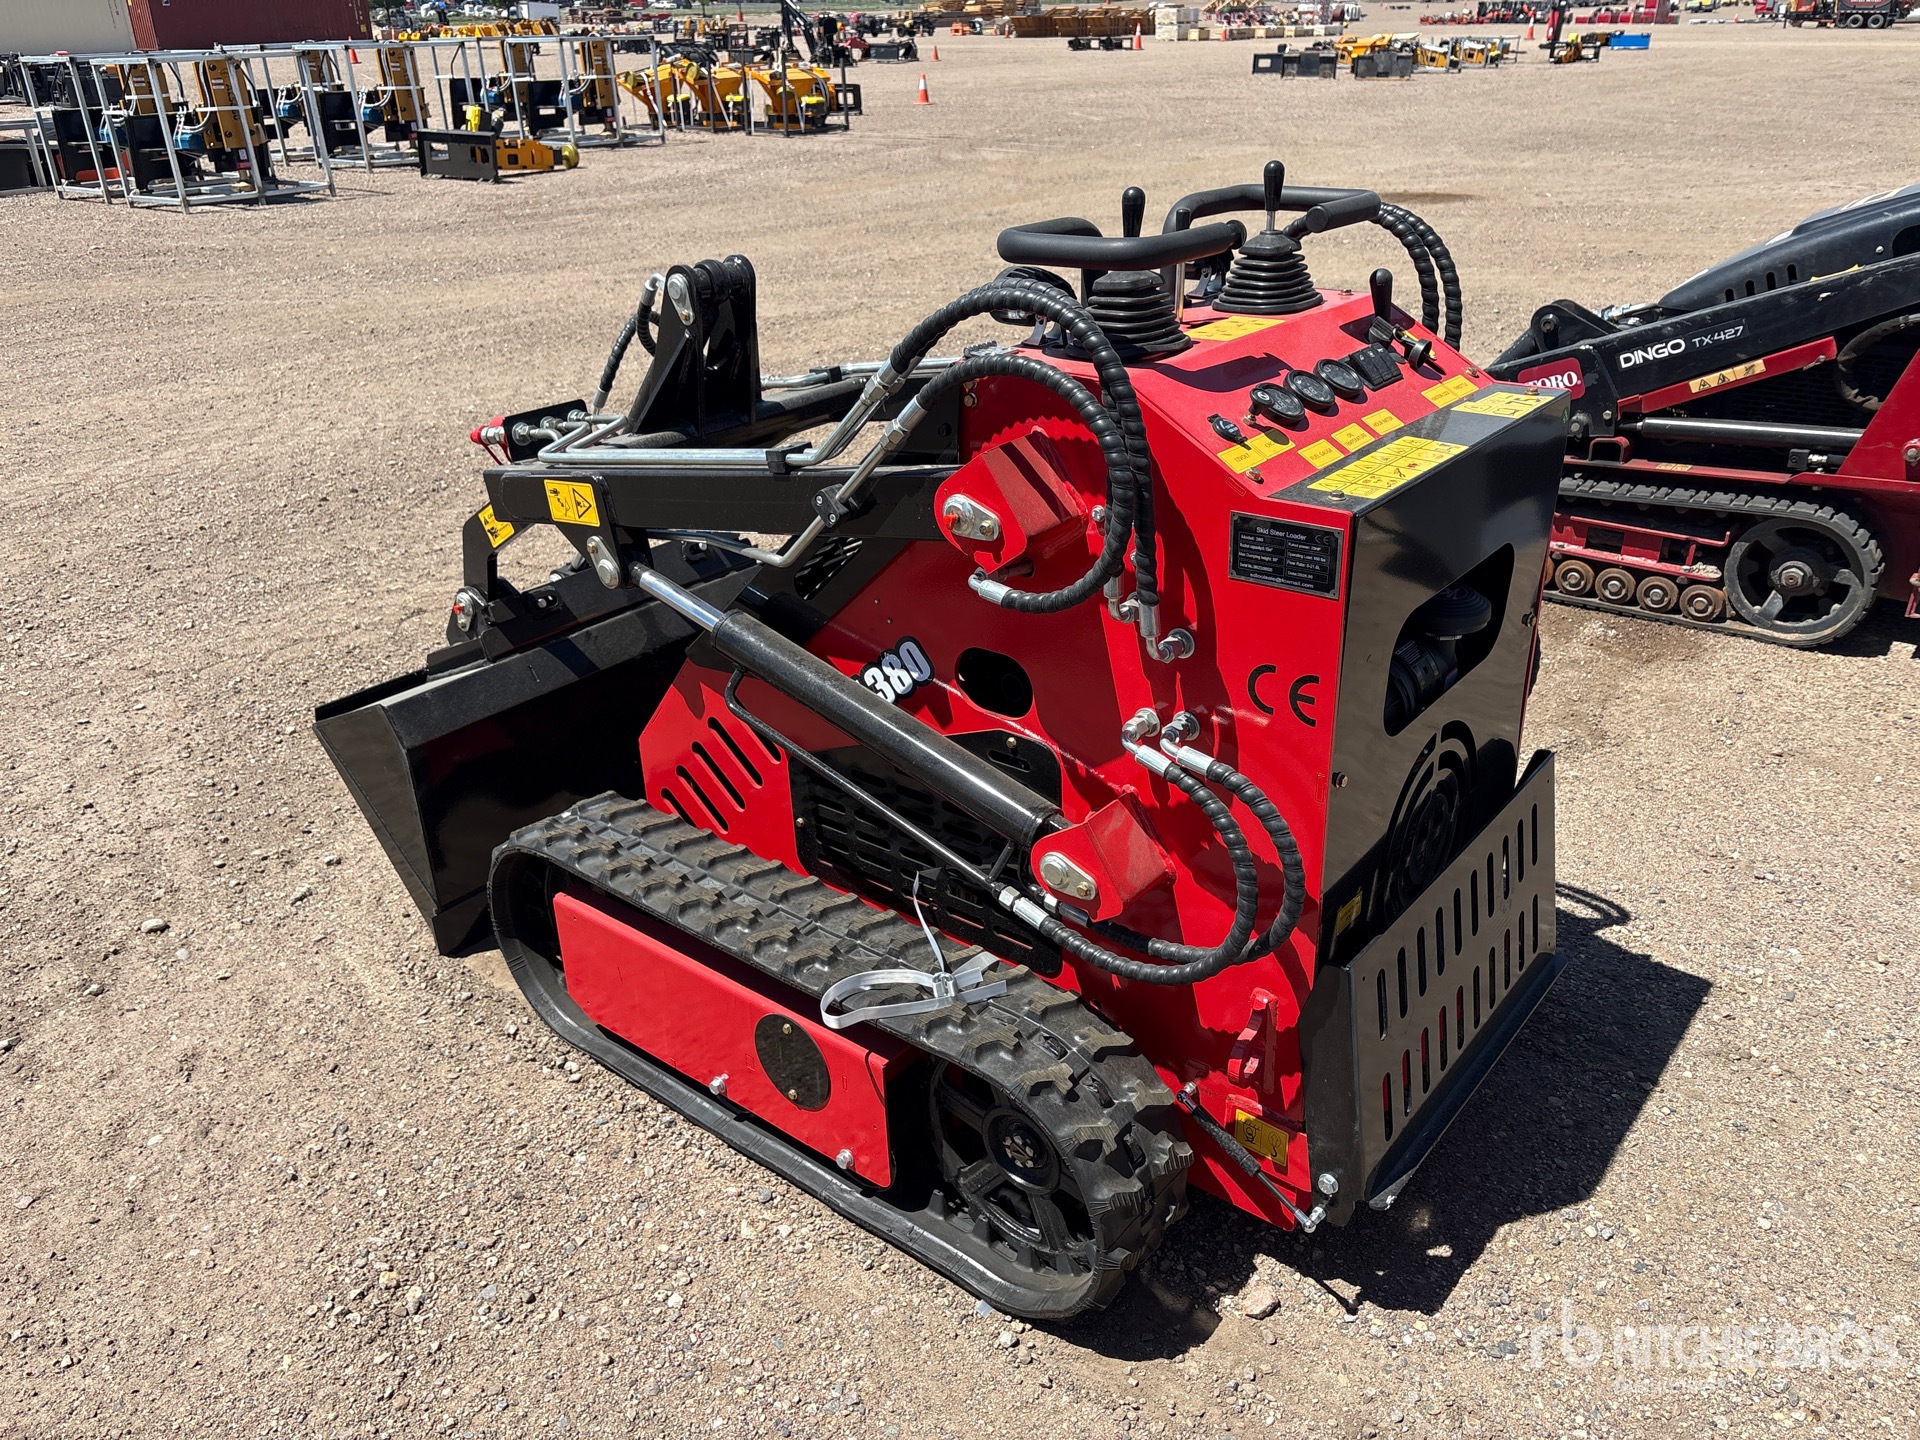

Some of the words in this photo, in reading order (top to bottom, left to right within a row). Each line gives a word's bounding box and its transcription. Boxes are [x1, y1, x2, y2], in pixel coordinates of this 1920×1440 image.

[1619, 339, 1685, 368] DINGO
[1257, 526, 1269, 535] Skid
[1270, 529, 1285, 537] Steer
[1286, 532, 1307, 541] Loader
[864, 641, 931, 703] 380
[1247, 664, 1320, 727] CE
